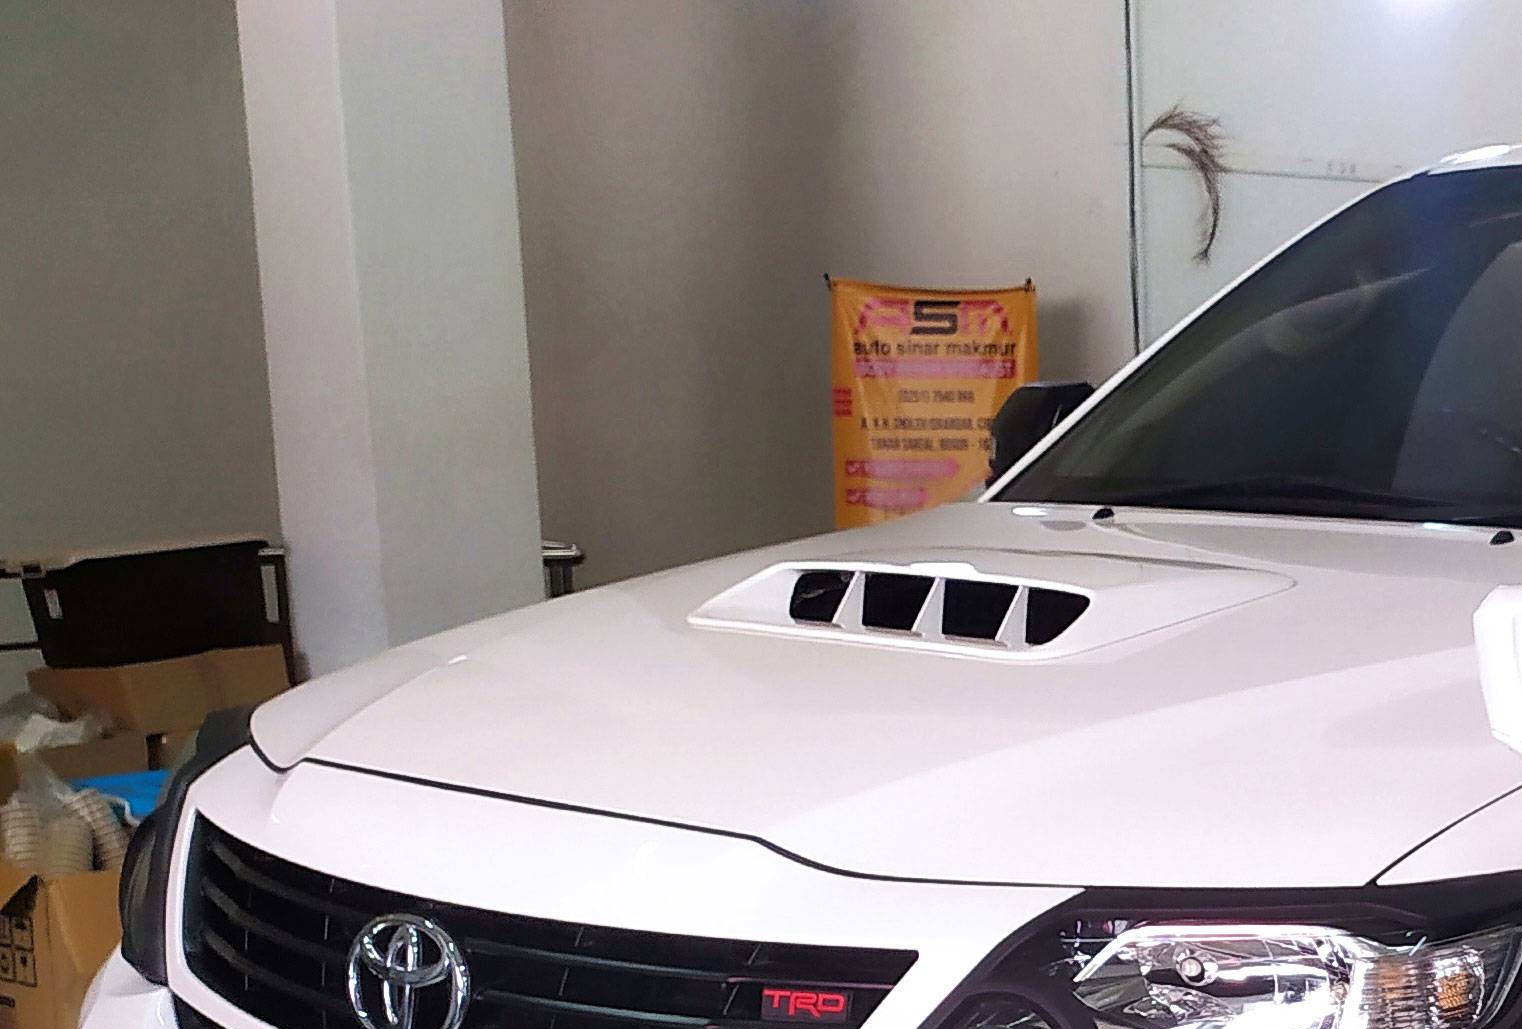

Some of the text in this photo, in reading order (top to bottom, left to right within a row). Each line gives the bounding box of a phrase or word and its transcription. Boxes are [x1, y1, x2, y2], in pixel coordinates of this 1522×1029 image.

[853, 340, 1016, 356] auto sinar makmur
[763, 988, 846, 1018] TRD
